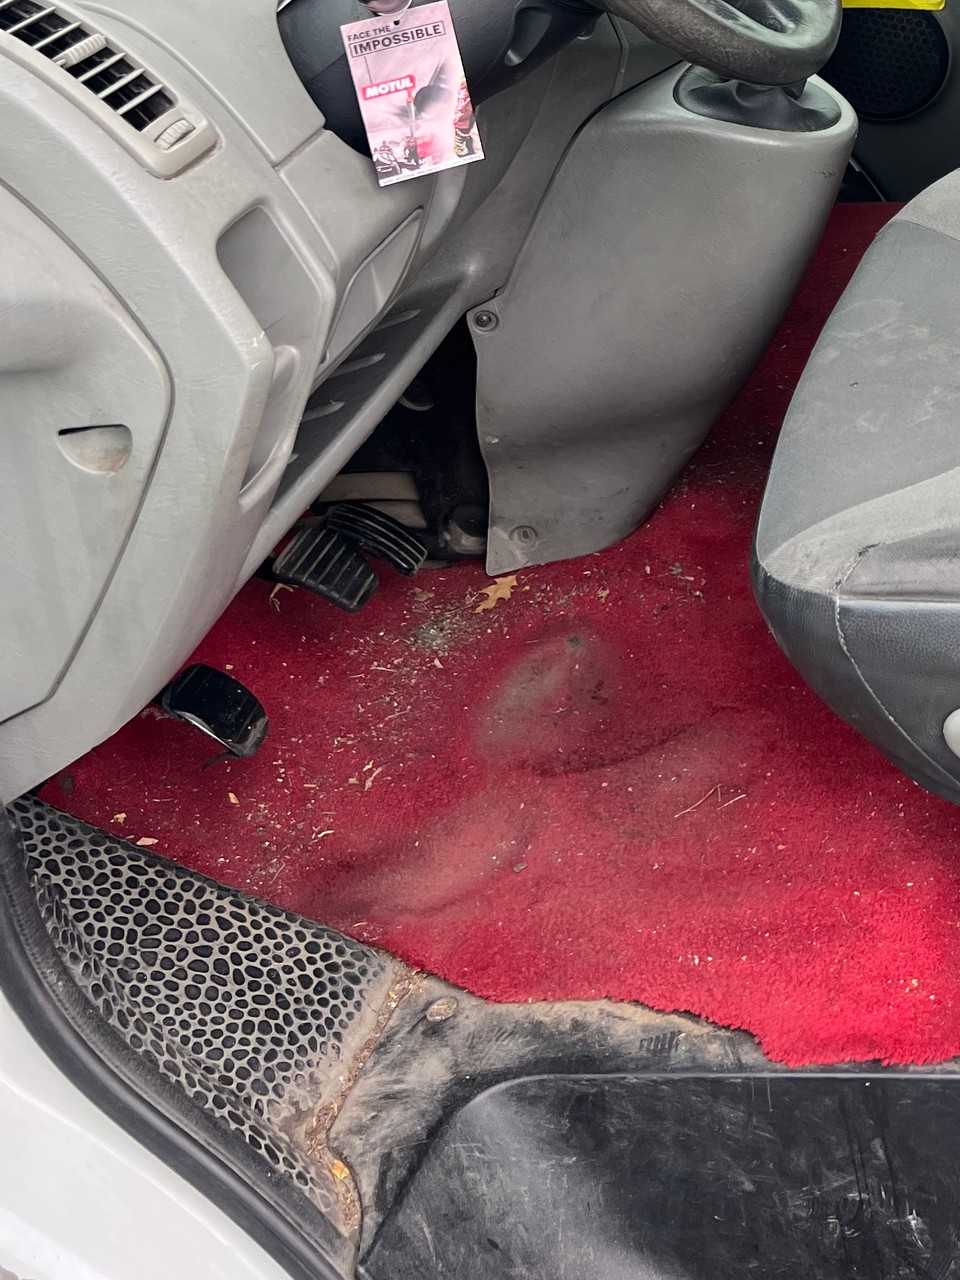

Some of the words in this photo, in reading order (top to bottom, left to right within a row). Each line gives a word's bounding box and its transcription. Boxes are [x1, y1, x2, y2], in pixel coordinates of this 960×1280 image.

[347, 30, 372, 42] FACE
[373, 25, 392, 36] THE
[353, 24, 442, 55] IMPOSSIBLE
[365, 77, 413, 99] MOTUL
